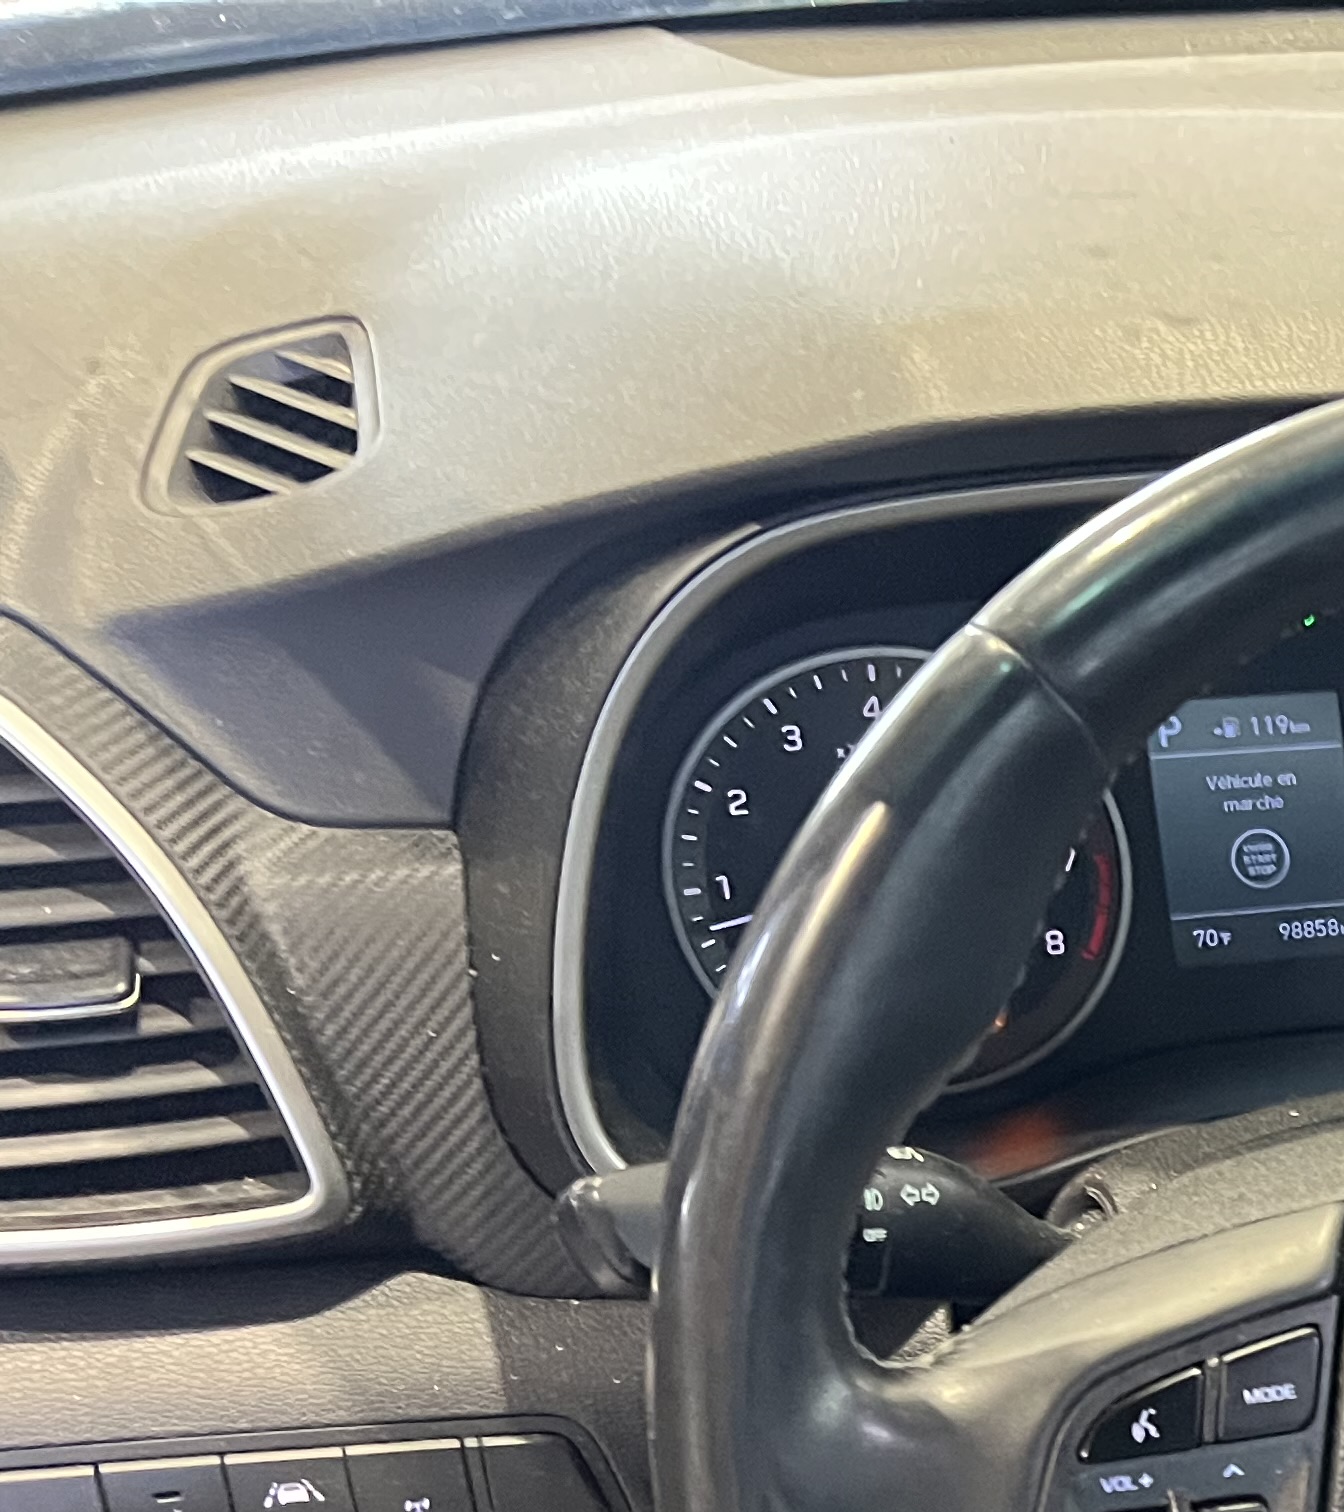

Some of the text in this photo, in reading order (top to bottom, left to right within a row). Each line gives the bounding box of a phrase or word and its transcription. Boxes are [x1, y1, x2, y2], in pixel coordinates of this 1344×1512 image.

[782, 725, 802, 752] 3
[1277, 771, 1297, 786] en
[726, 790, 749, 816] 2
[1223, 794, 1285, 813] marche
[715, 875, 732, 900] 1
[1045, 929, 1065, 955] 8
[1242, 1382, 1298, 1406] MODE
